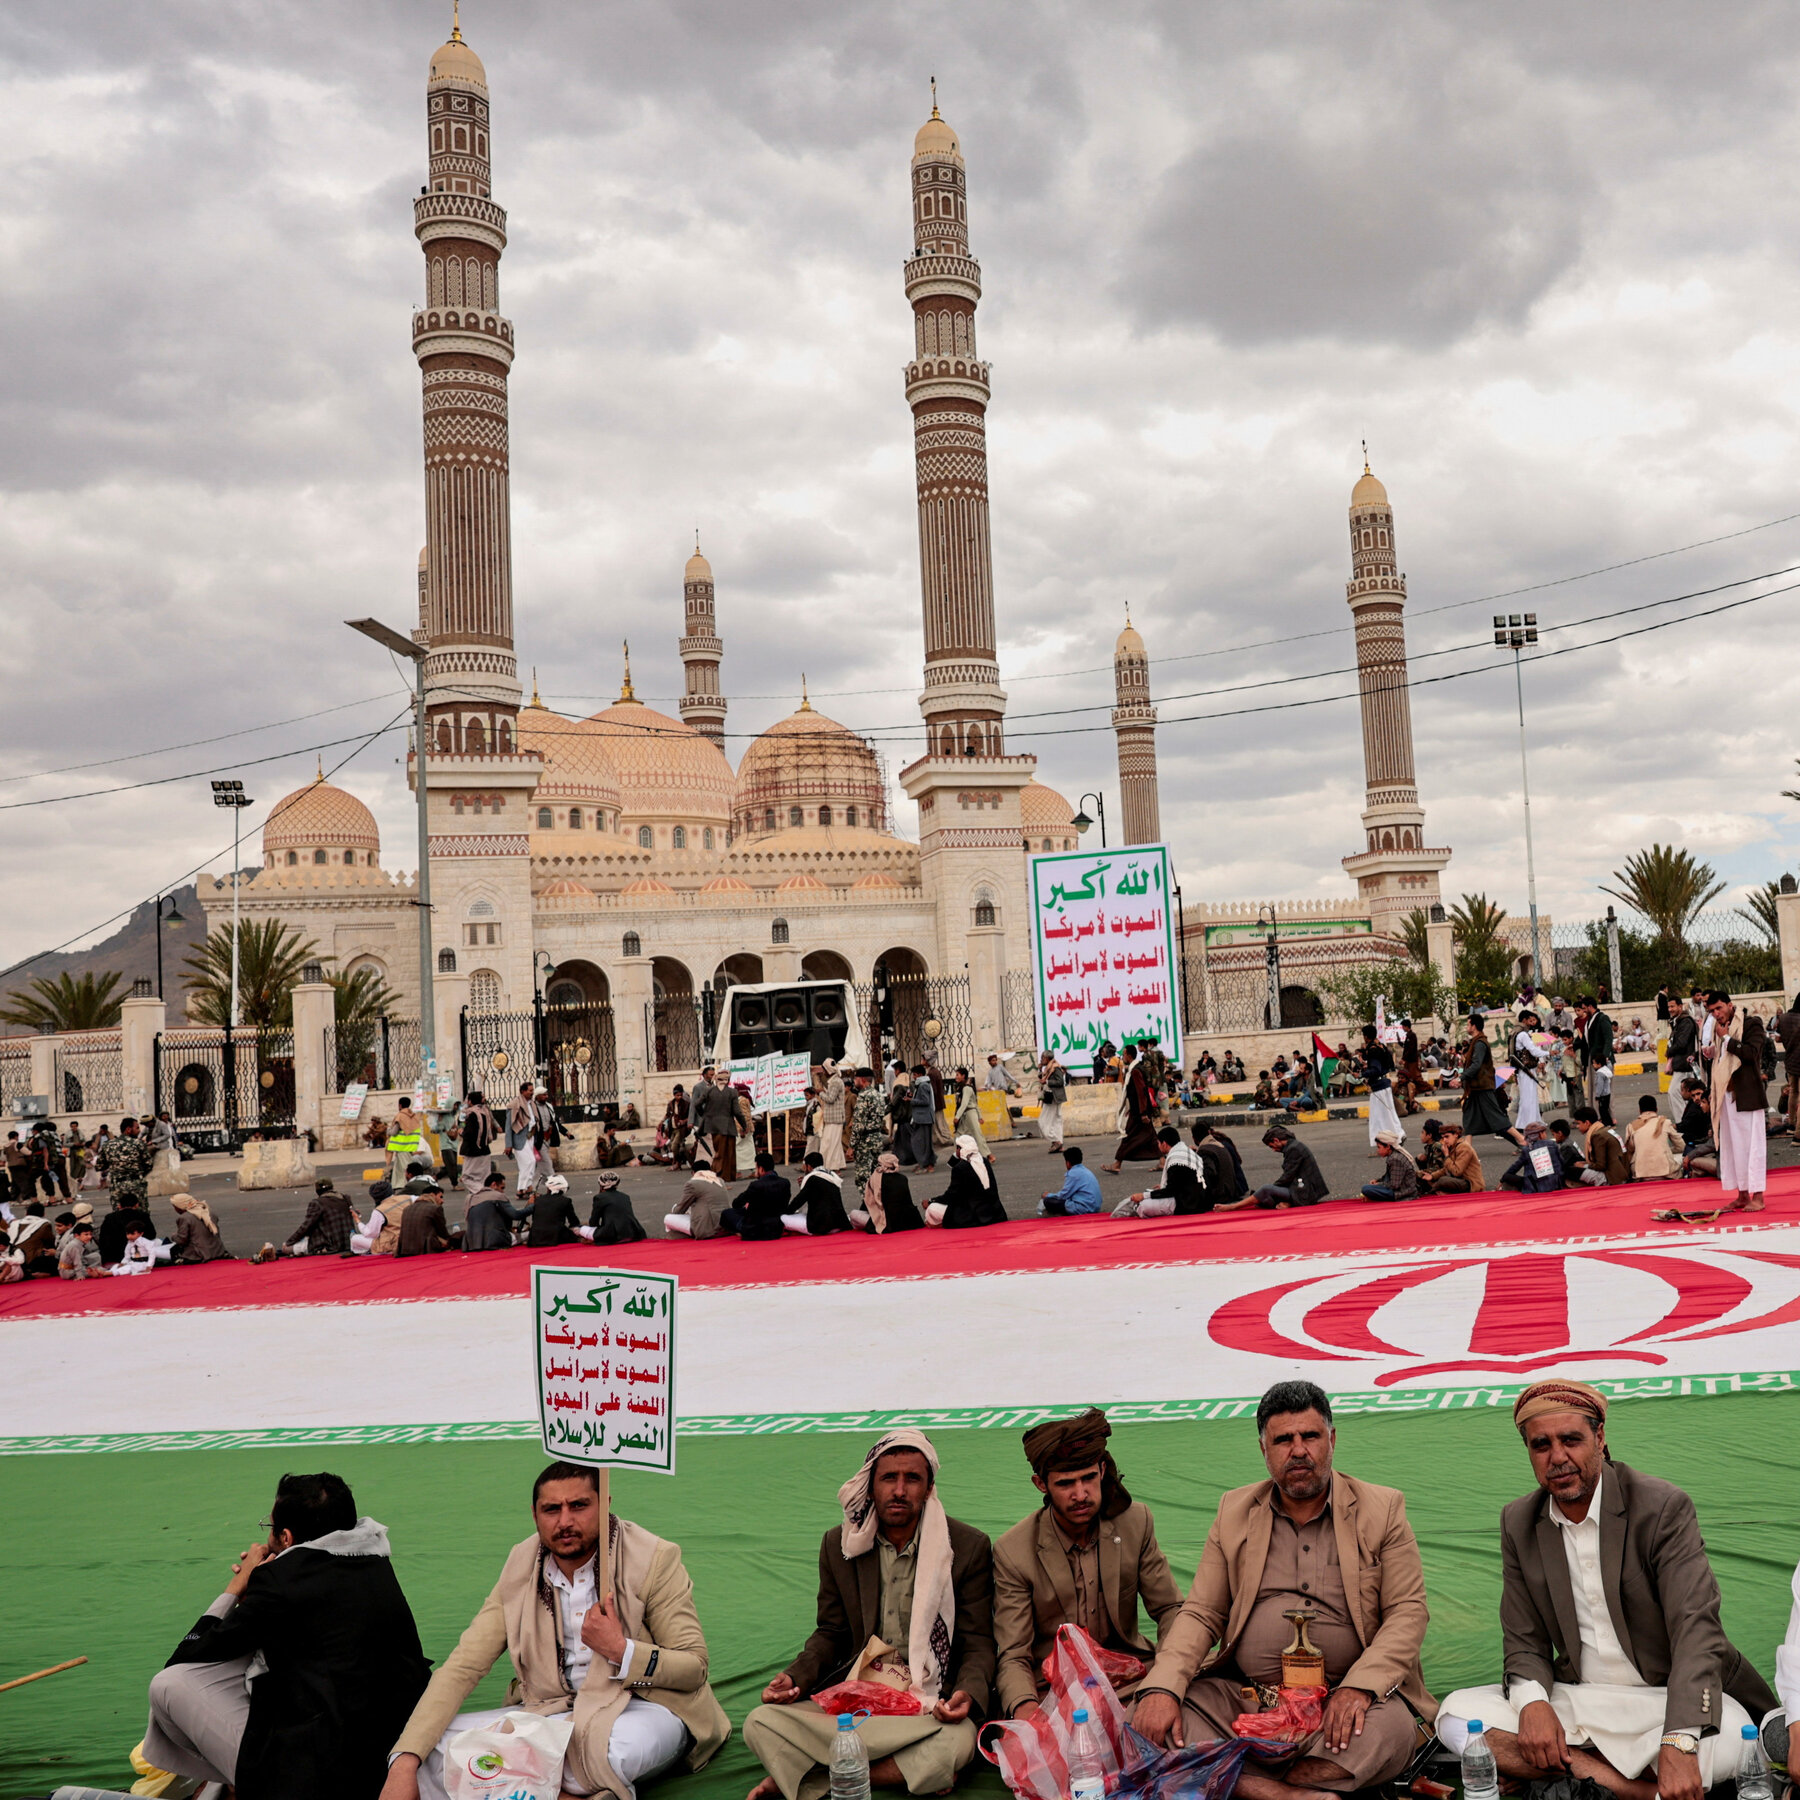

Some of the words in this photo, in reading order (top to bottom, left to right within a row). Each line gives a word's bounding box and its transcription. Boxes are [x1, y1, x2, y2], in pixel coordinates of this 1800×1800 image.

[1042, 859, 1112, 913] أكبر
[1116, 860, 1161, 896] الله
[1044, 908, 1105, 942] لأمريكا
[1111, 909, 1162, 937] الموت
[1047, 949, 1107, 980] لإسرائيل
[1113, 946, 1164, 974] الموت
[1048, 987, 1091, 1016] اليهود
[1097, 986, 1121, 1013] على
[1128, 981, 1167, 1006] اللعنة
[543, 1279, 620, 1322] أكبر
[623, 1286, 667, 1318] الله
[545, 1322, 610, 1350] لأمريكا
[616, 1332, 666, 1353] الموت
[545, 1356, 610, 1385] لإسرائيل
[615, 1364, 665, 1386] الموت
[546, 1391, 589, 1414] اليهود
[595, 1392, 620, 1416] على
[627, 1392, 665, 1417] اللعنة
[548, 1417, 606, 1456] للإسلام
[611, 1421, 664, 1455] النصر
